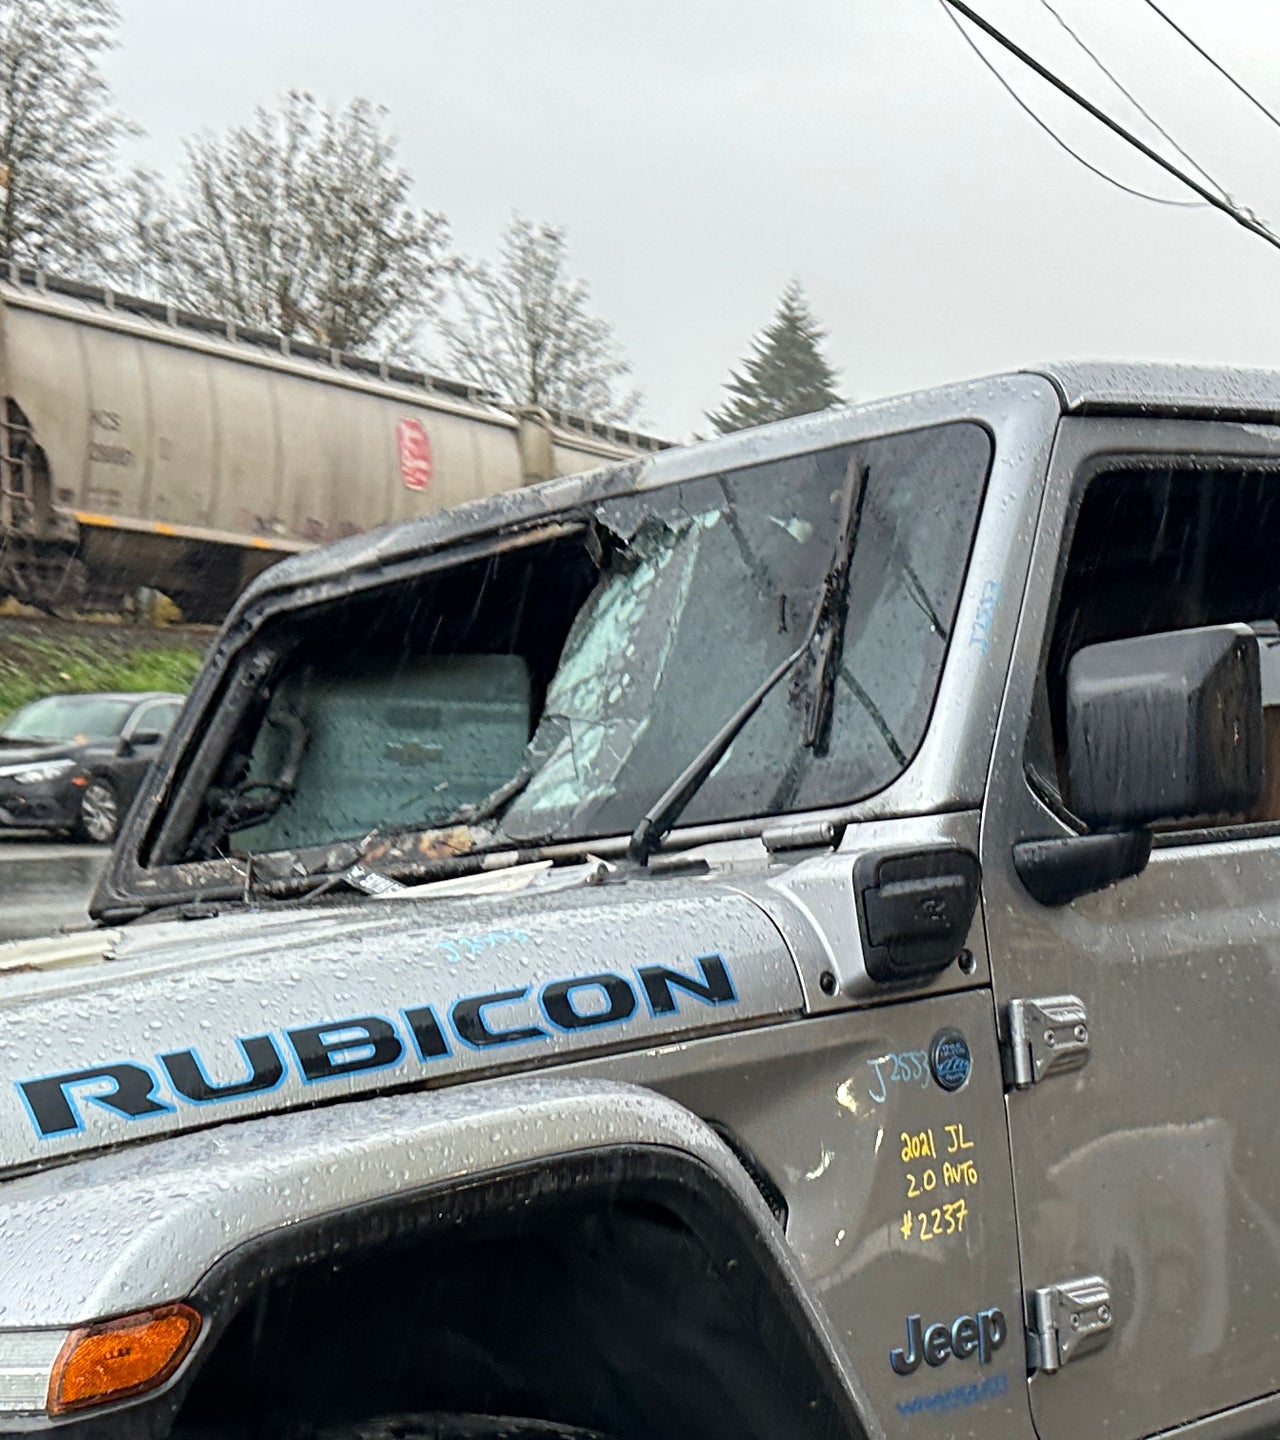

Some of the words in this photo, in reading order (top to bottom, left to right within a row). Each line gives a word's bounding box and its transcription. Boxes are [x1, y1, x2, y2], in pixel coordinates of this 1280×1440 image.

[15, 953, 739, 1141] RUBICON
[900, 1127, 937, 1162] 2021
[943, 1122, 975, 1153] JL
[906, 1168, 937, 1198] 2.0
[900, 1198, 969, 1241] #2237
[889, 1305, 1008, 1376] Jeep
